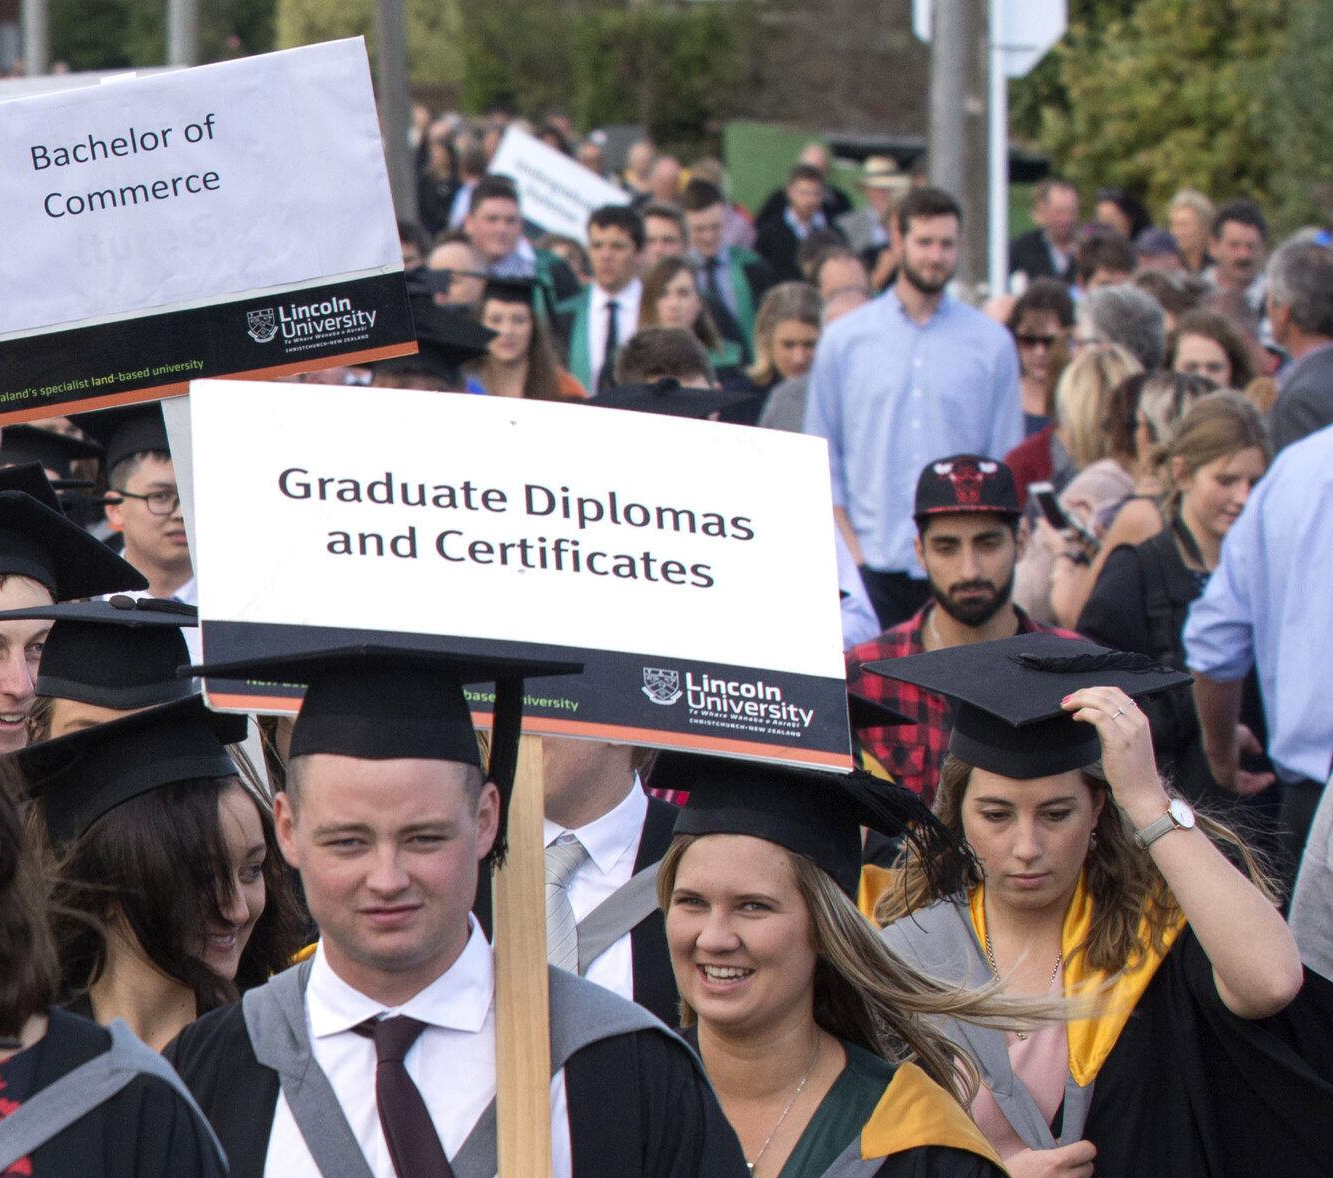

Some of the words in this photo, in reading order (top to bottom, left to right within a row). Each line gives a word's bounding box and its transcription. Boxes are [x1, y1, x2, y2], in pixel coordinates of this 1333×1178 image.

[30, 127, 173, 171] Bachelor
[184, 113, 216, 143] of
[43, 169, 221, 218] Commerce
[278, 297, 351, 322] Lincoln
[281, 309, 377, 338] University
[40, 379, 90, 399] specialist
[91, 367, 150, 387] land-based
[152, 359, 204, 378] university
[277, 467, 509, 515] Graduate
[523, 482, 756, 542] Diplomas
[325, 524, 419, 560] and
[434, 528, 716, 589] Certificates
[685, 671, 782, 702] Lincoln
[686, 688, 814, 728] University
